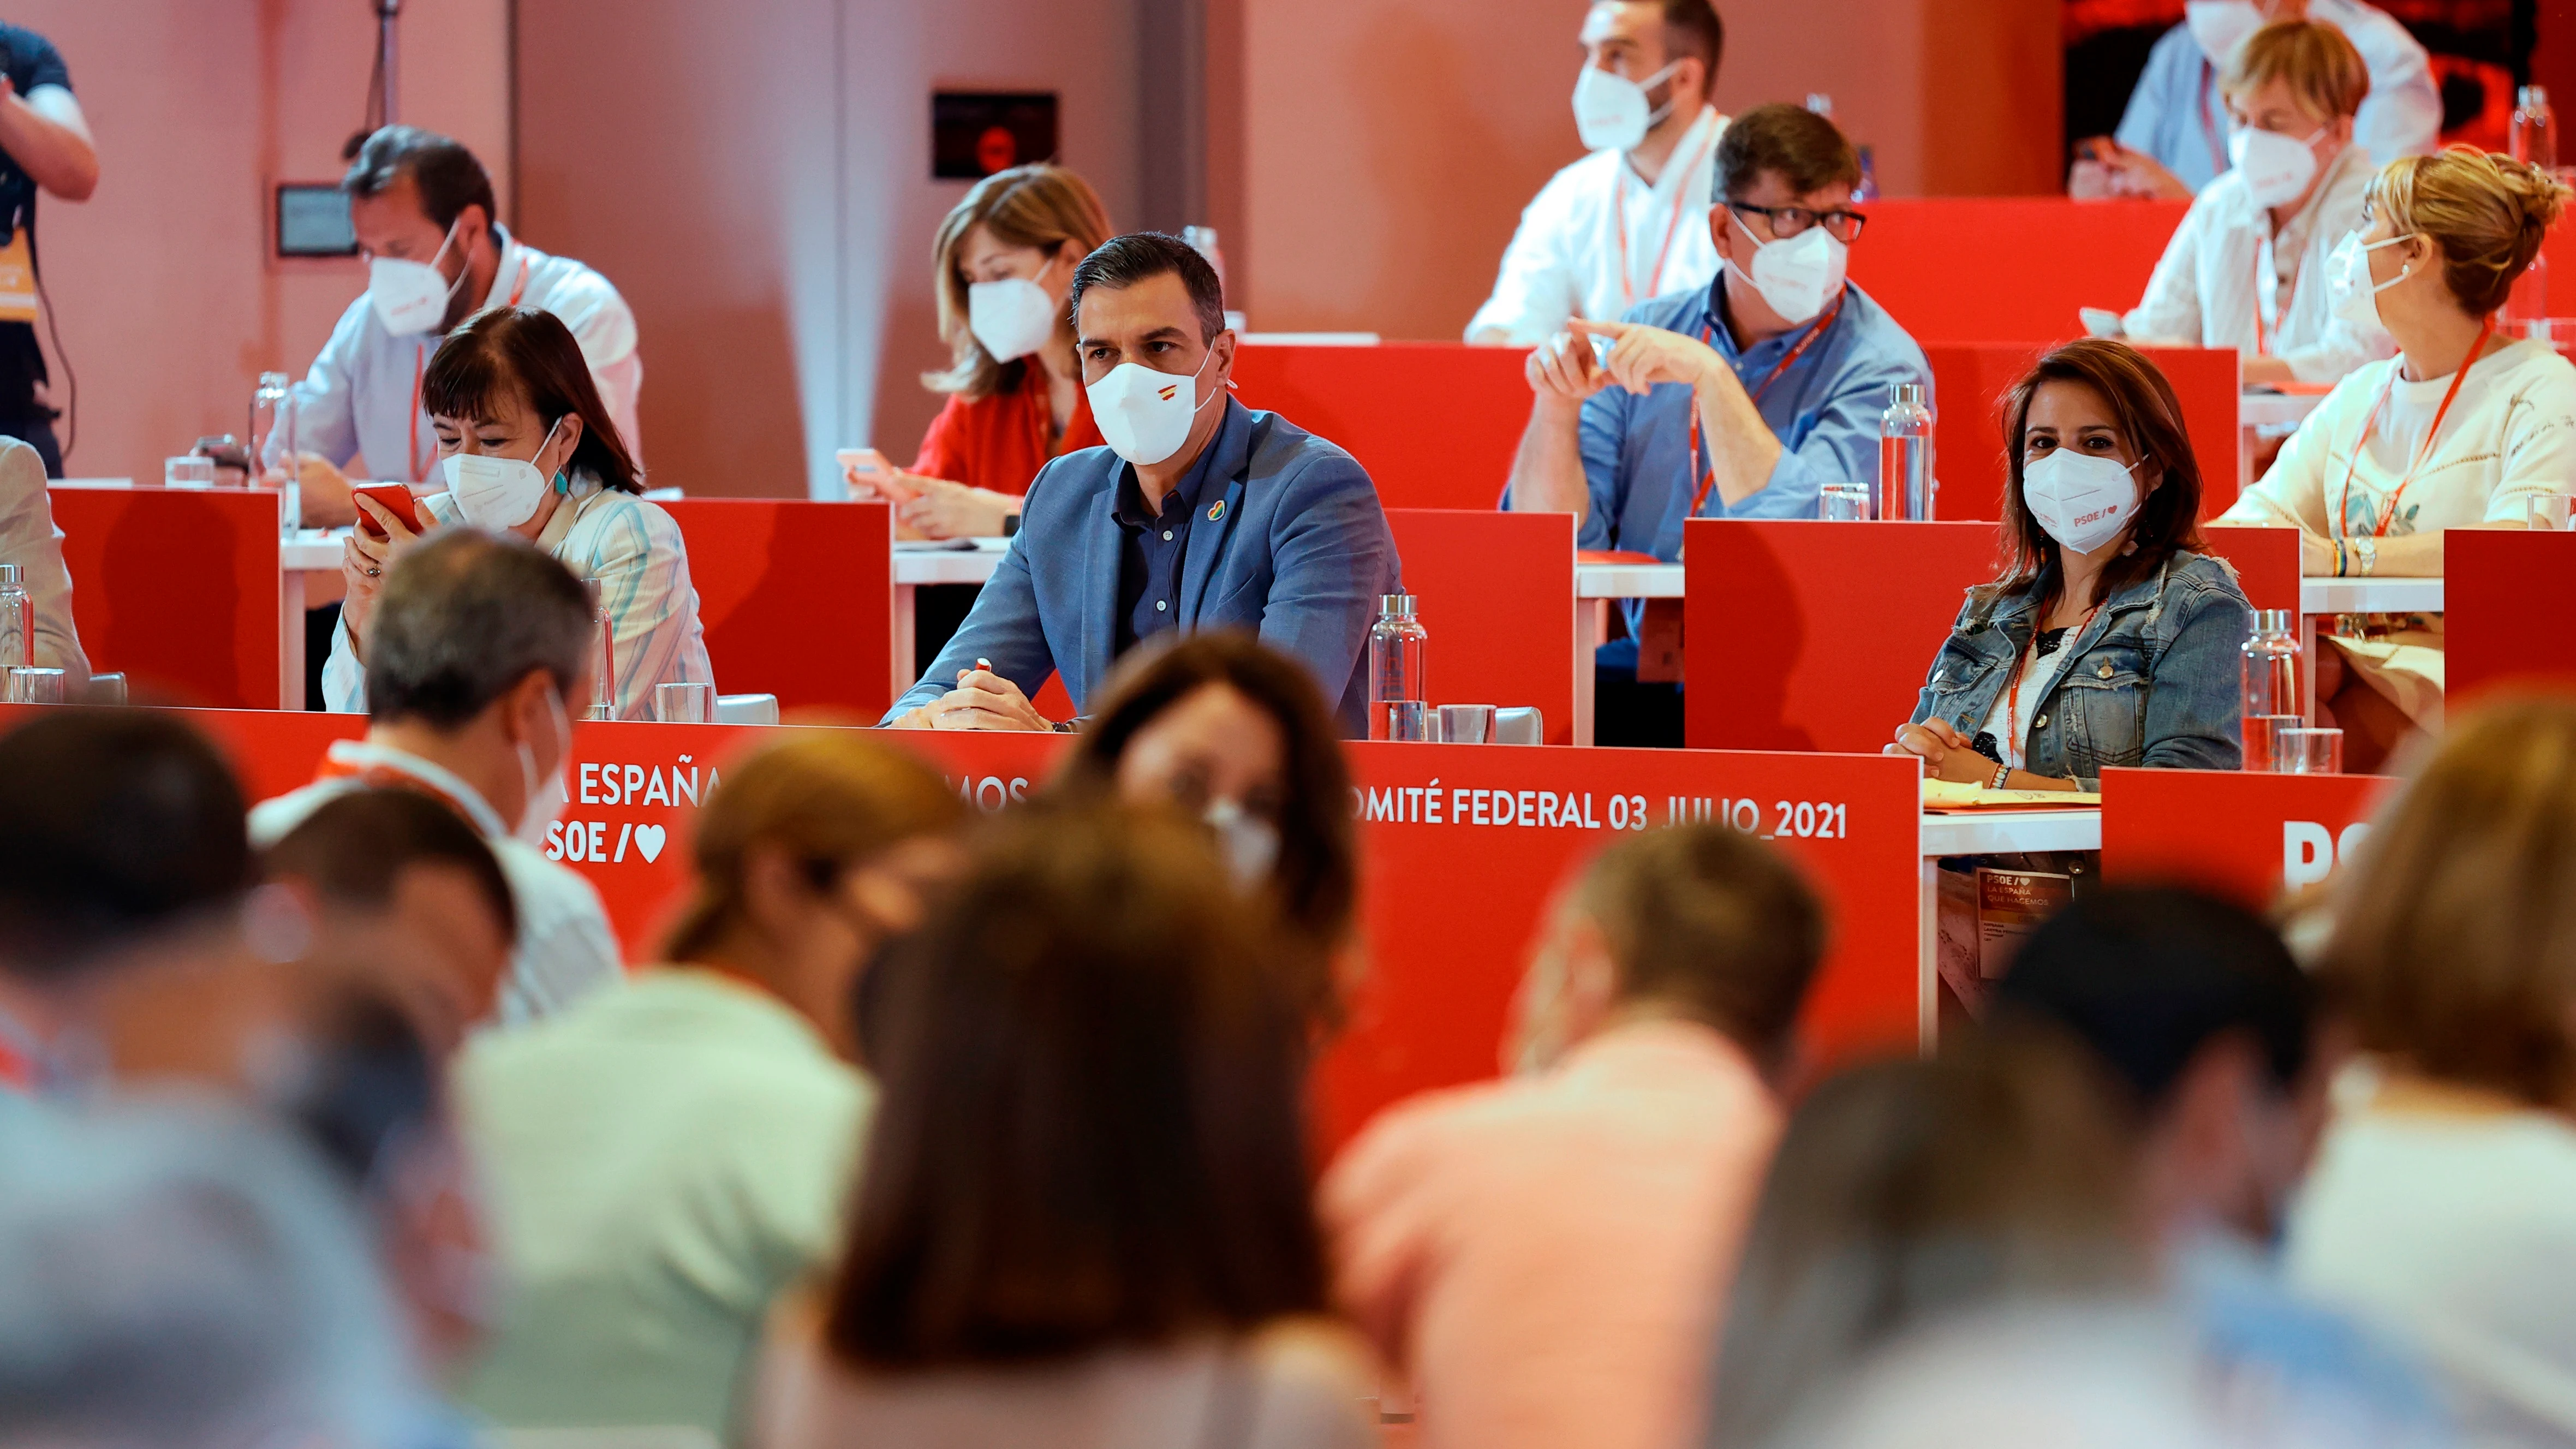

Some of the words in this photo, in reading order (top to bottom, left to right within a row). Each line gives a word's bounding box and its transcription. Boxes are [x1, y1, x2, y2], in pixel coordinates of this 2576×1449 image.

[2074, 511, 2100, 527] PSOE
[1452, 788, 1601, 829] FEDERAL
[541, 820, 606, 862] SOE
[1987, 875, 2012, 885] PSOE
[2000, 887, 2031, 896] ESPAÑA
[2007, 897, 2049, 906] HACEMOS
